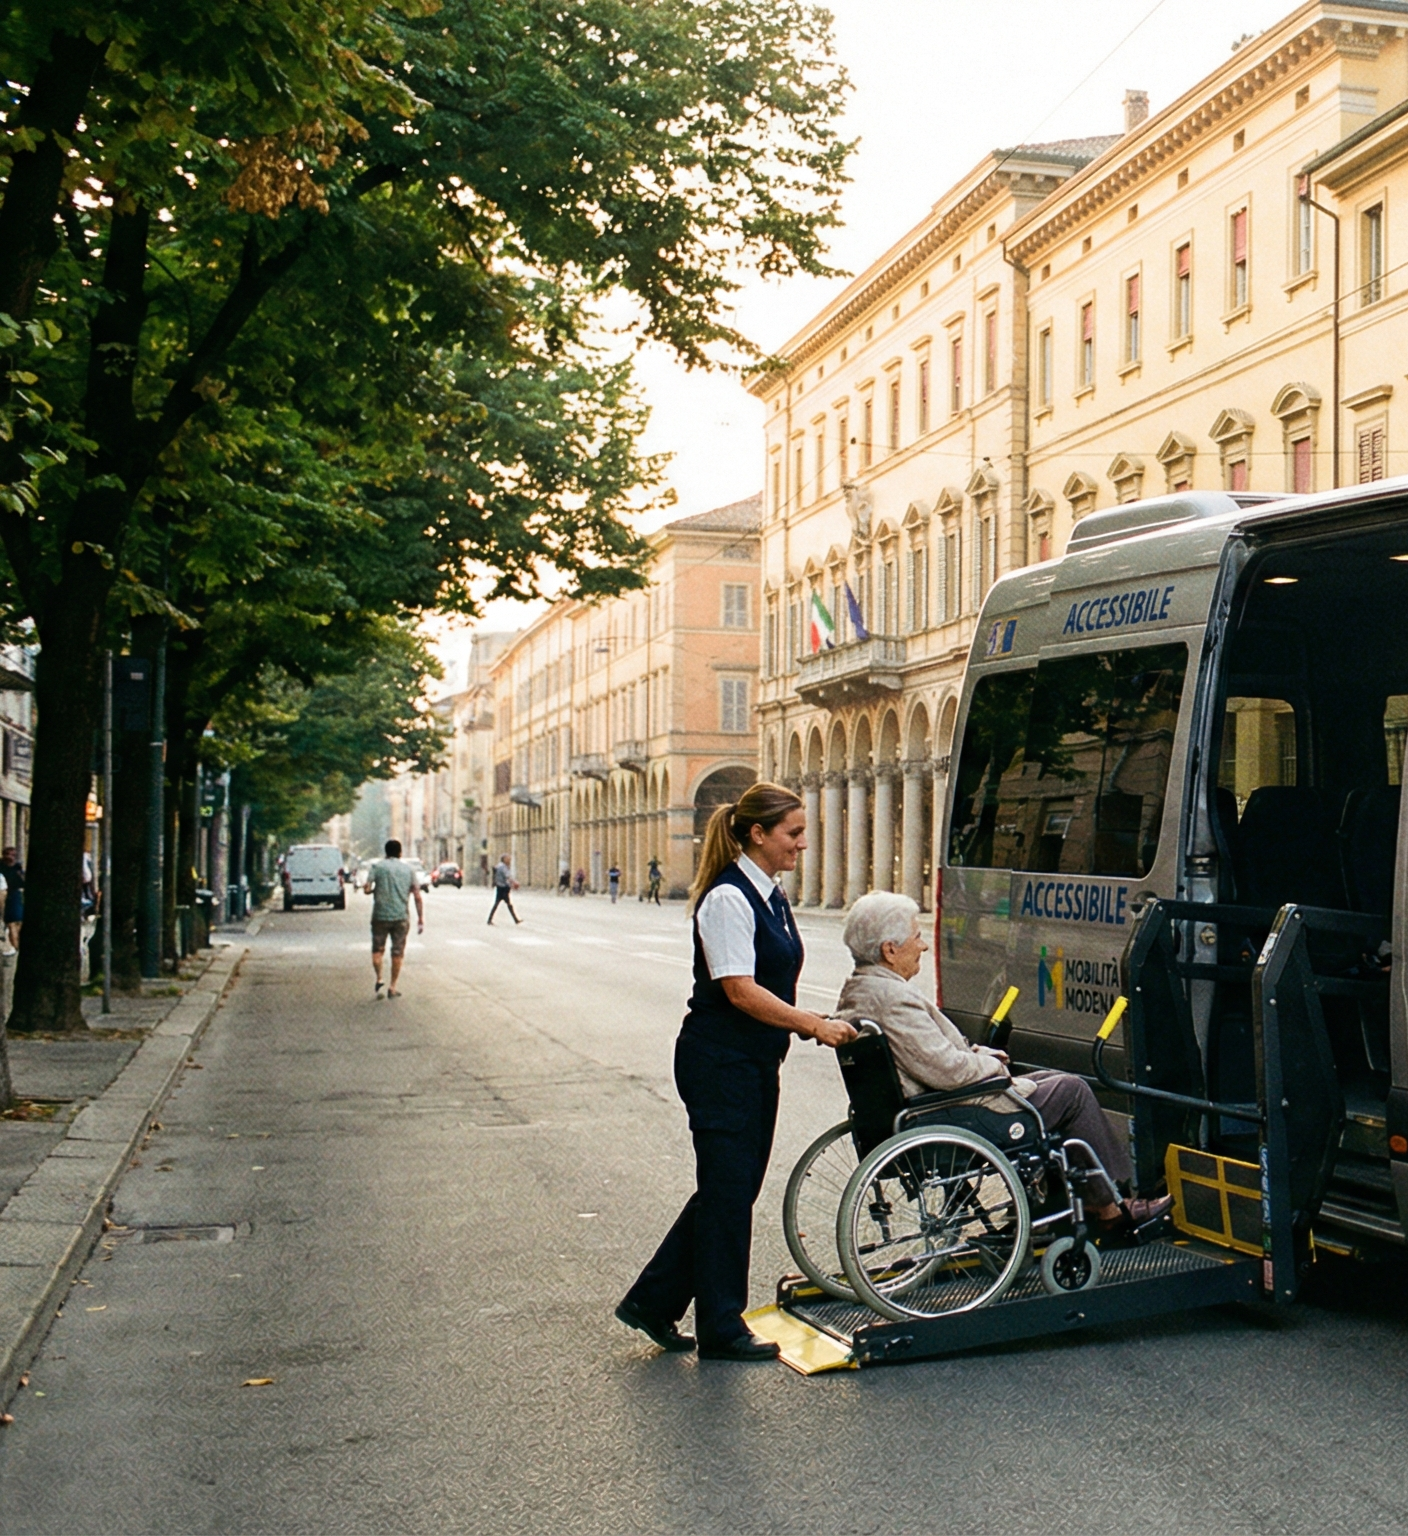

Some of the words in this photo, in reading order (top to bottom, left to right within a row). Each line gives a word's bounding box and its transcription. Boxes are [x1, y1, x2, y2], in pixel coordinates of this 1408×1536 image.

[1063, 586, 1175, 634] ACCESSIBILE
[1021, 881, 1128, 925] ACCESSIBILE
[1065, 957, 1119, 988] MOBILITÀ
